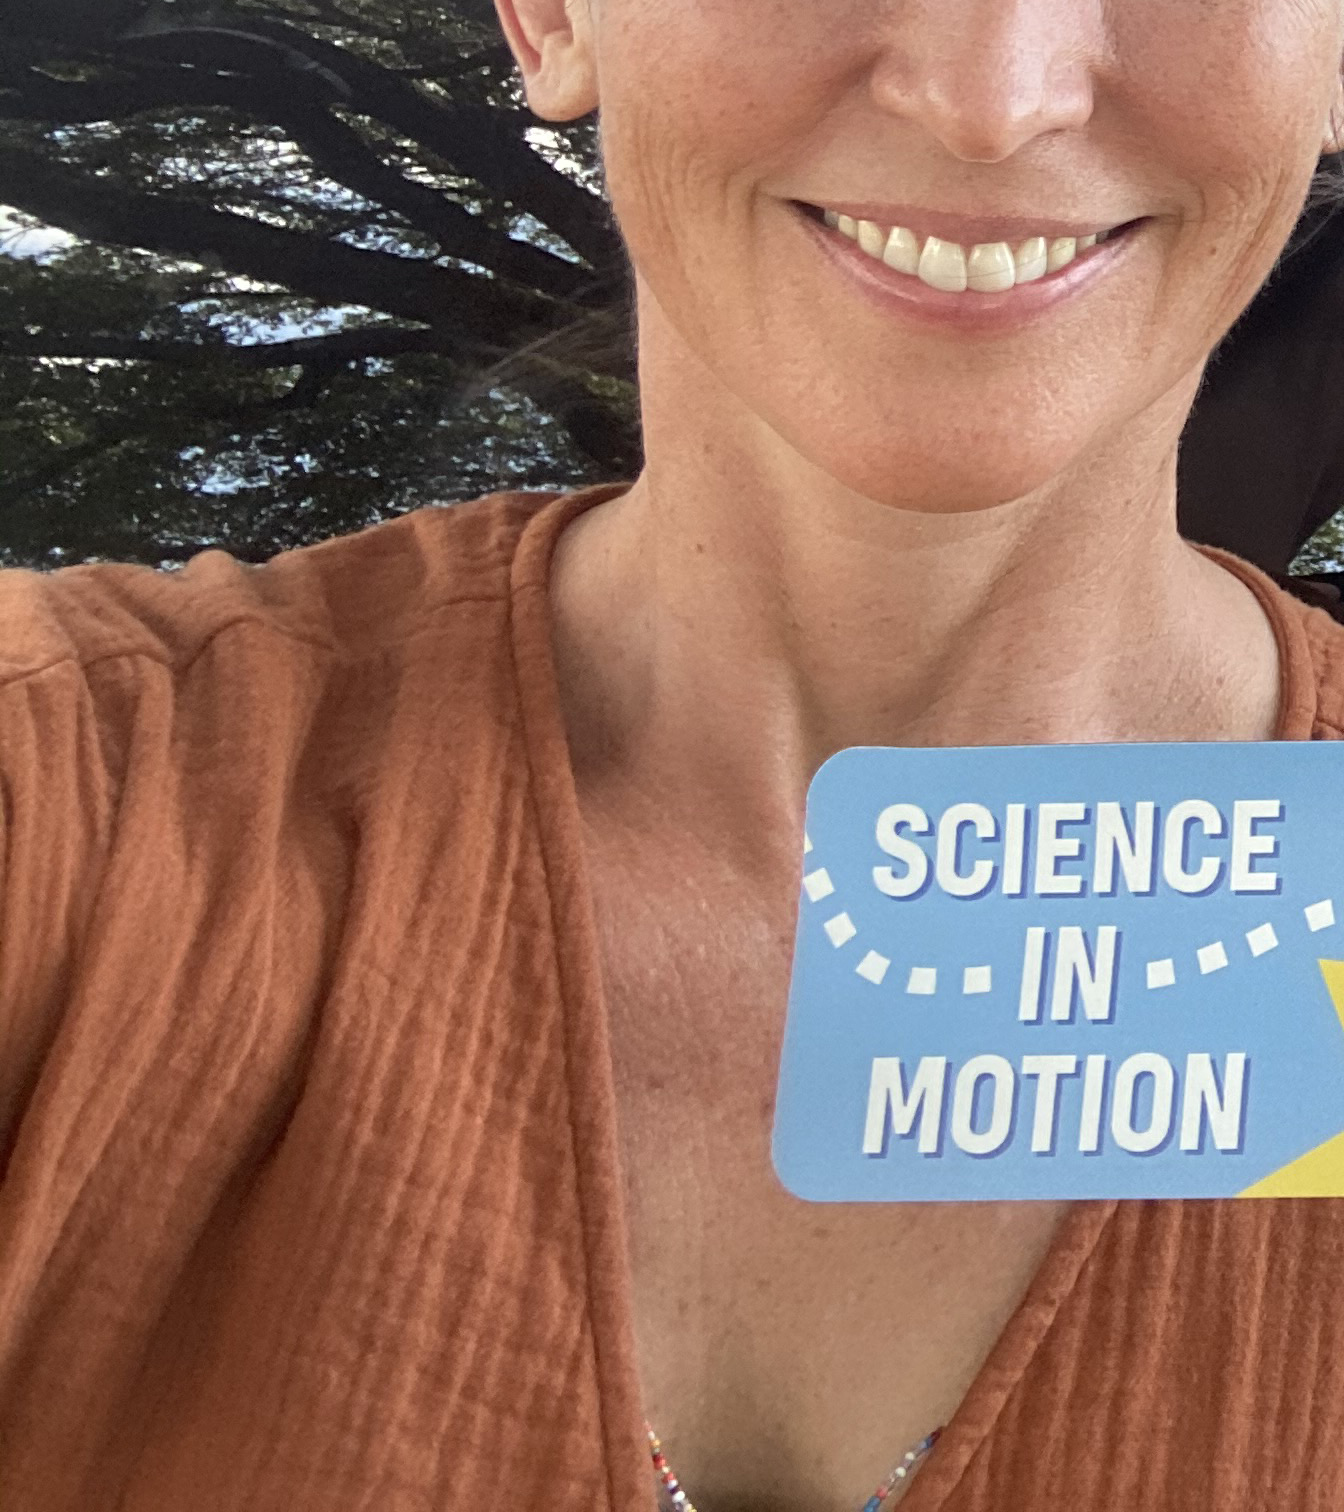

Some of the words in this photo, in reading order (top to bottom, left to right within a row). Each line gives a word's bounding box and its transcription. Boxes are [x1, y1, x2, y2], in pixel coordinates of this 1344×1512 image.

[872, 798, 1286, 899] SCIENCE
[1017, 925, 1122, 1025] IN
[862, 1051, 1250, 1158] MOTION
